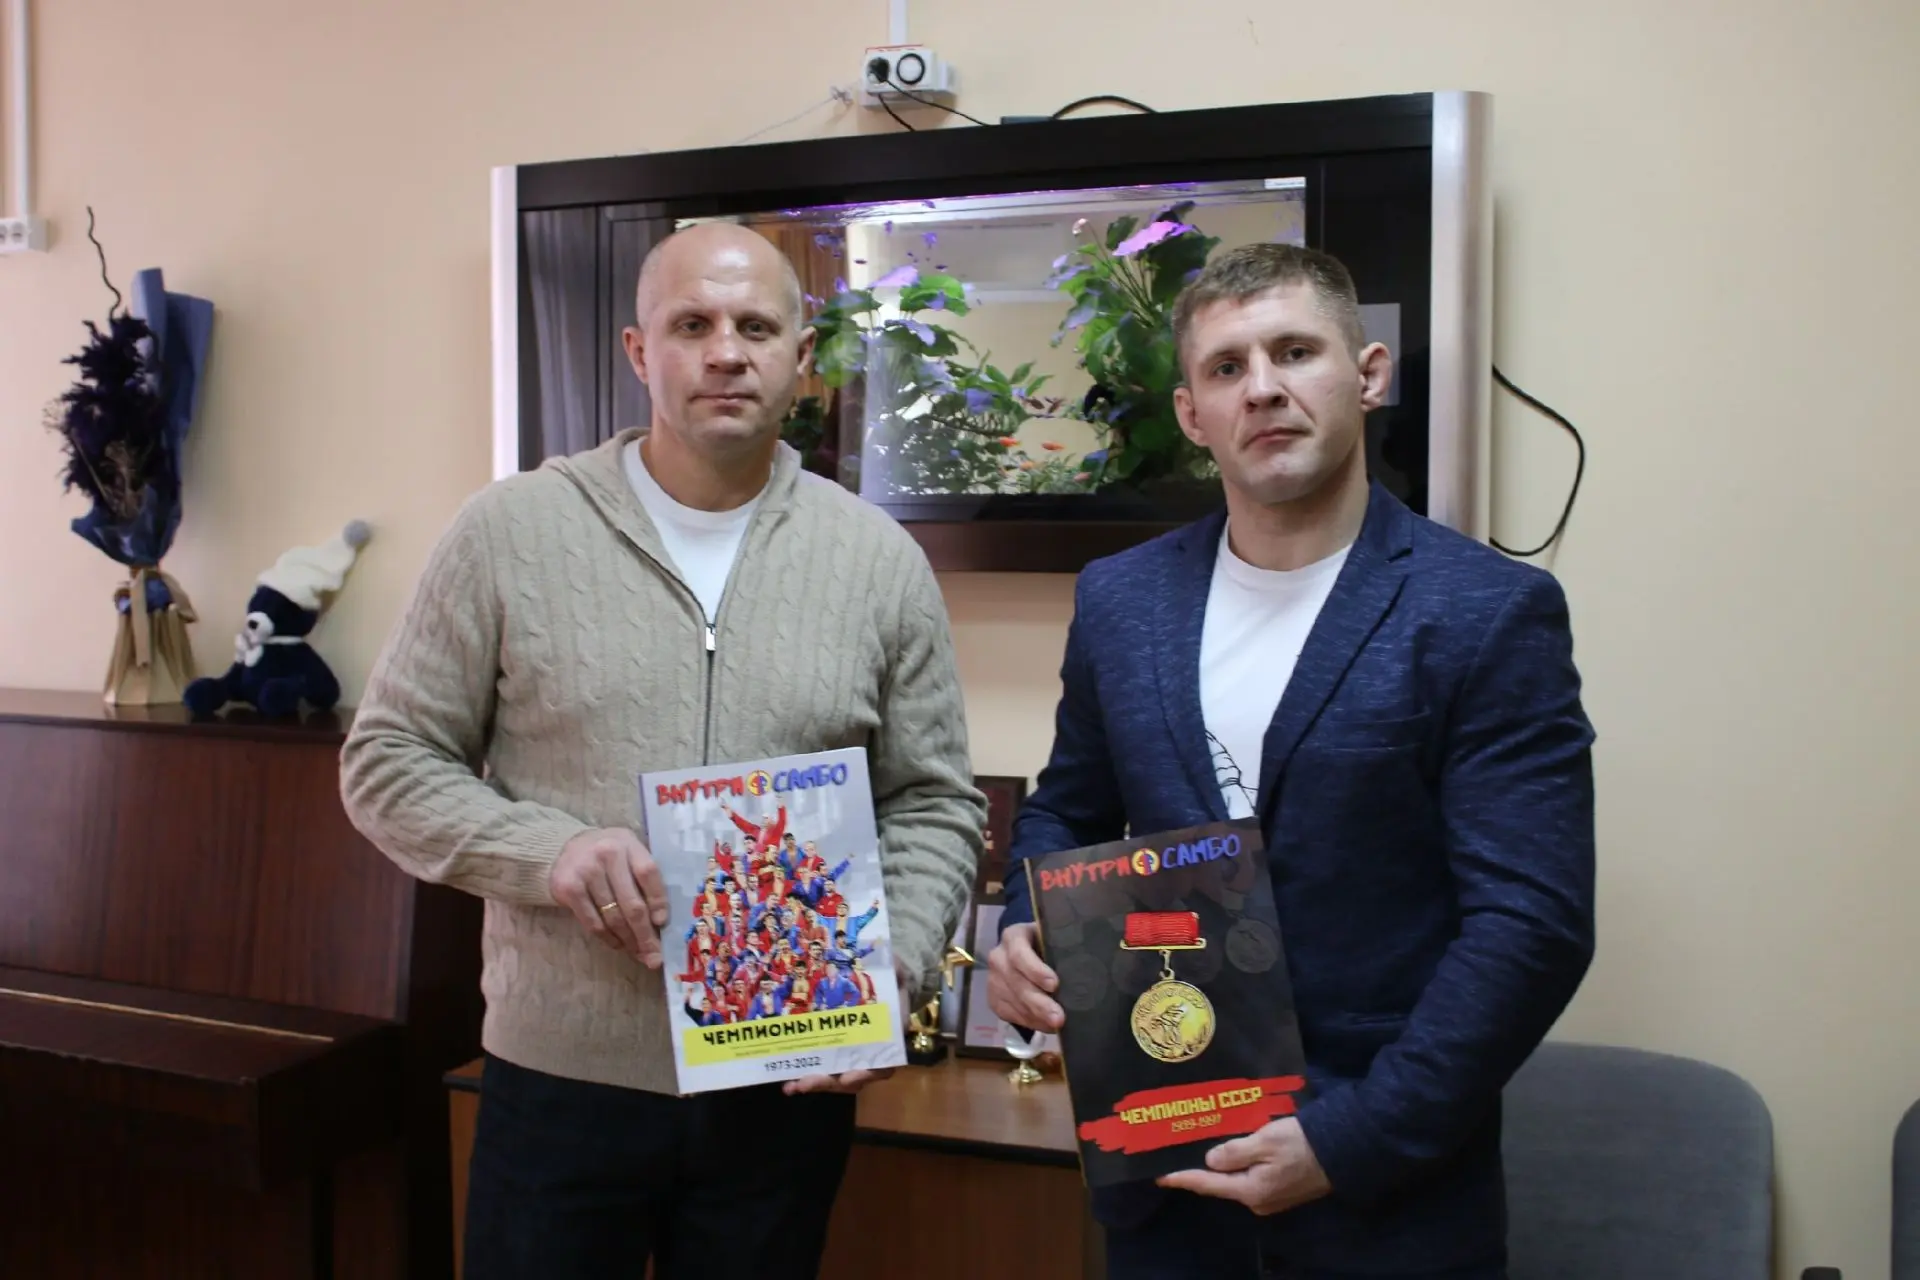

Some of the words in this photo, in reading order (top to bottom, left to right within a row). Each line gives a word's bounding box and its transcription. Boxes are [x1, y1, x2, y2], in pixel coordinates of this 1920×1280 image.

[656, 776, 744, 805] ВНУТРИ
[773, 763, 847, 792] САМБО
[1040, 856, 1131, 890] ВНУТРИ
[1162, 834, 1240, 868] САМБО
[703, 1018, 812, 1046] ЧЕМПИОНЫ
[819, 1012, 871, 1031] МИРА
[764, 1056, 822, 1072] 1973-2022
[1120, 1095, 1216, 1125] ЧЕМПИОНЫ
[1218, 1086, 1262, 1108] СССР
